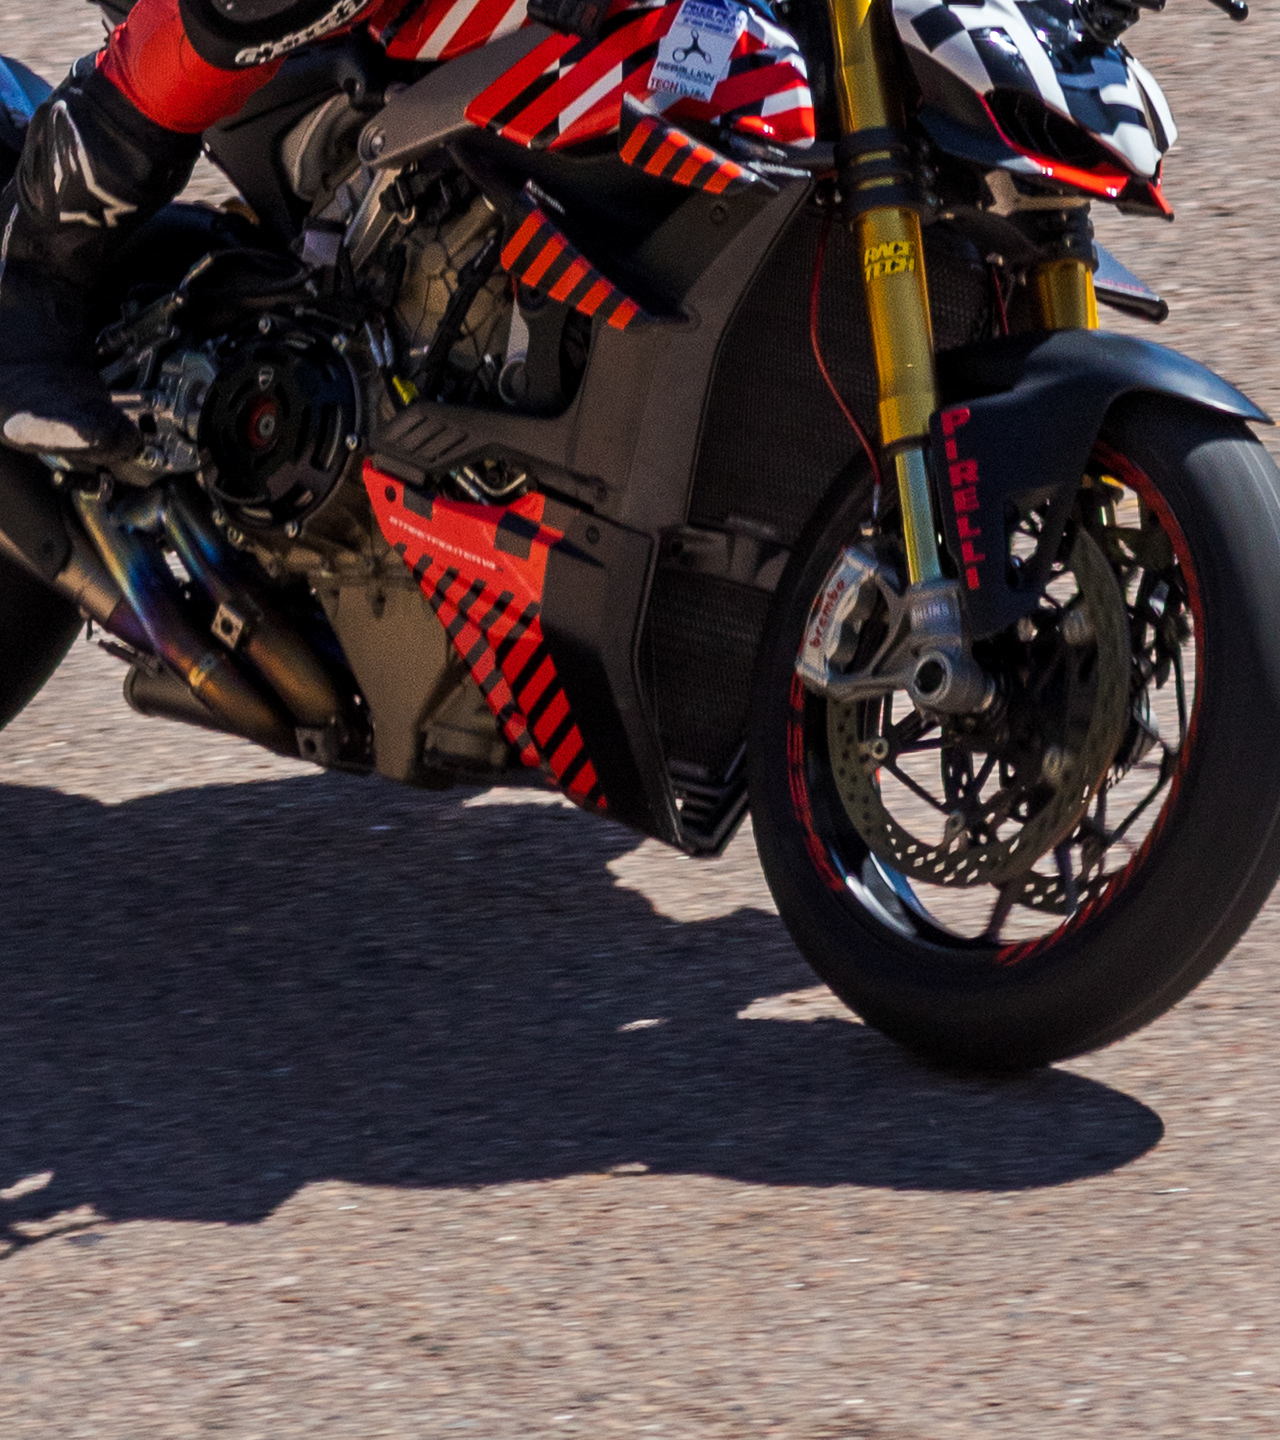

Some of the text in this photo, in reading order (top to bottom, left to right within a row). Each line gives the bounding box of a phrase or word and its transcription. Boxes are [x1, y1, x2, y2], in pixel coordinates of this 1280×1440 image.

[864, 241, 914, 267] RACE
[865, 257, 915, 283] TECH
[940, 407, 986, 591] PIRELLI
[809, 579, 847, 649] brembo
